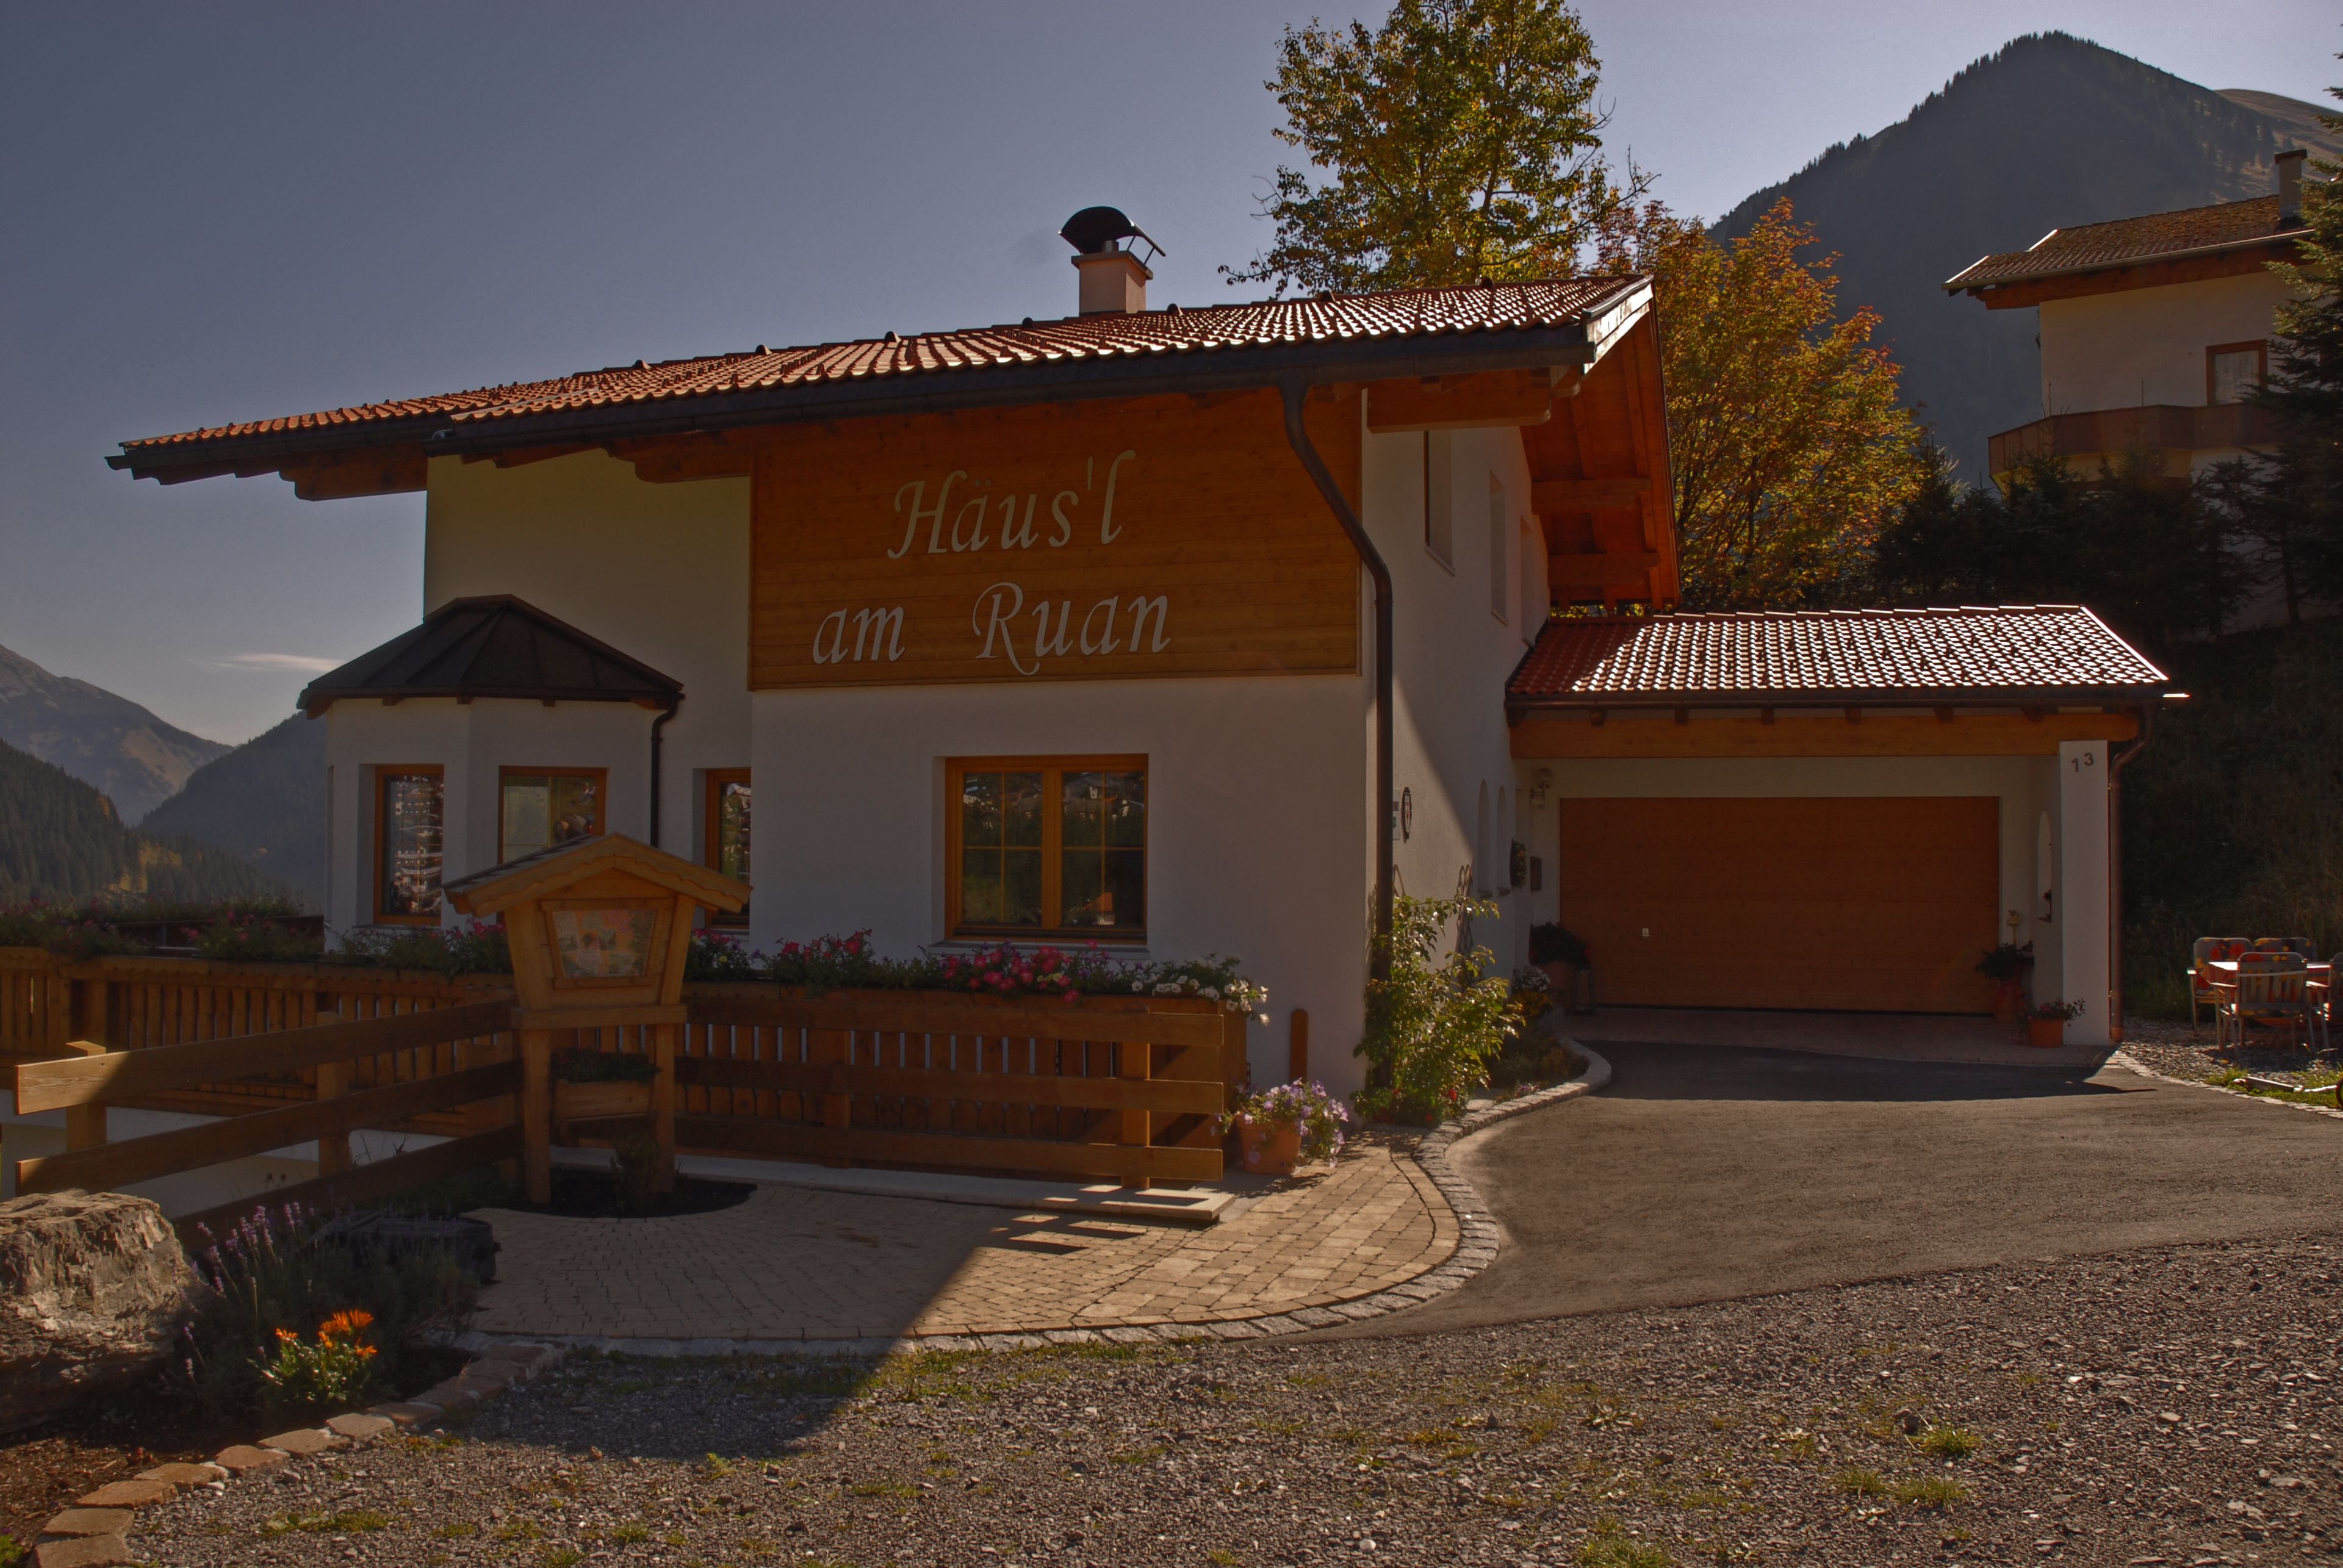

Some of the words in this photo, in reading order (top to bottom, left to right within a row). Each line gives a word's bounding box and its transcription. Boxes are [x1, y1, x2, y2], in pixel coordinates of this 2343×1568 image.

[887, 450, 1136, 559] Häus'l
[813, 606, 905, 664] am
[972, 582, 1170, 675] Ruan
[2071, 752, 2094, 772] 13
